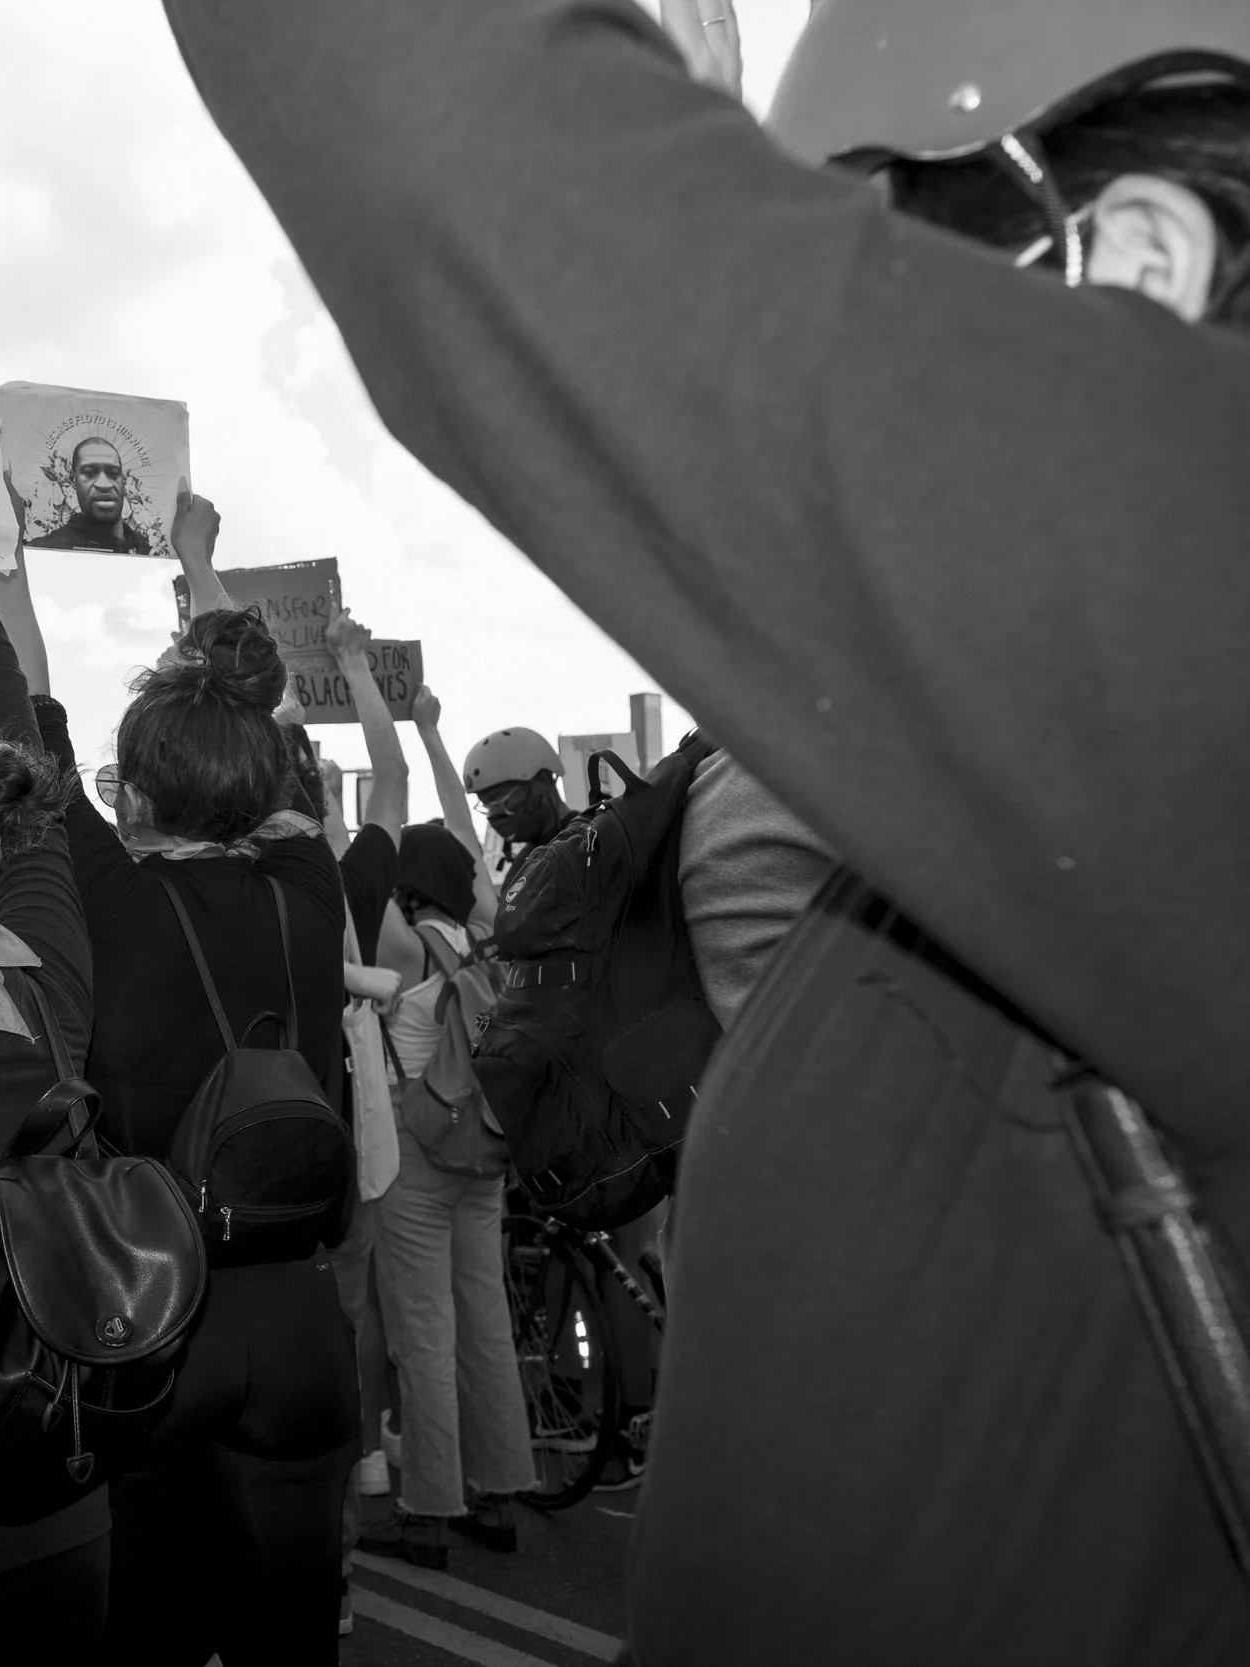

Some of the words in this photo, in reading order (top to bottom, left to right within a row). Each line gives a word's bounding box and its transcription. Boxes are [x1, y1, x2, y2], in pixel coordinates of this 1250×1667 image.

[45, 417, 76, 450] GEORGE
[75, 414, 106, 426] FLOYD
[106, 418, 118, 430] IS
[116, 423, 133, 441] HIS
[130, 438, 151, 467] NAME
[381, 645, 411, 671] FOR
